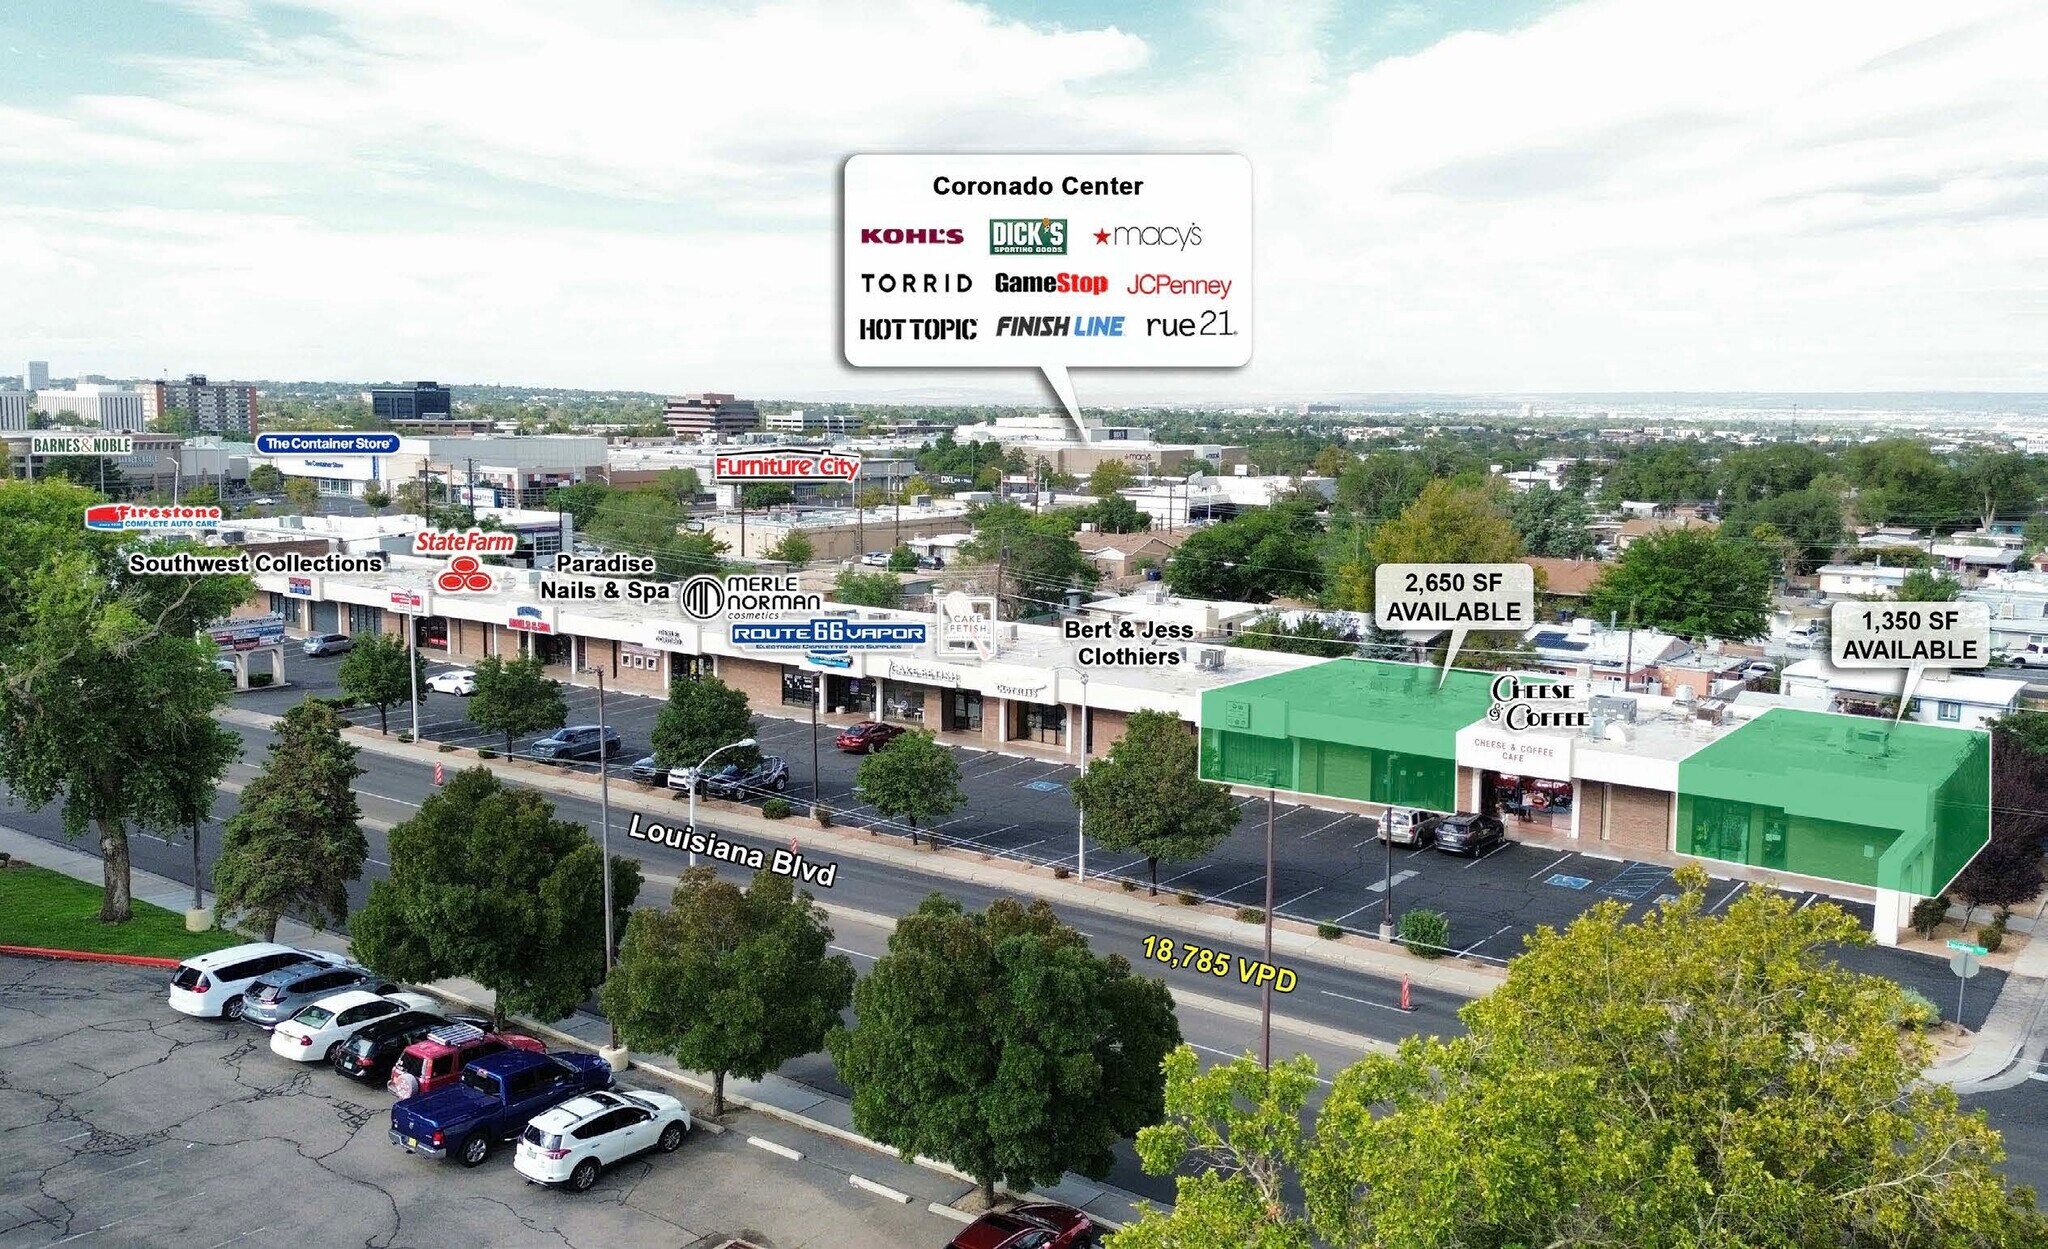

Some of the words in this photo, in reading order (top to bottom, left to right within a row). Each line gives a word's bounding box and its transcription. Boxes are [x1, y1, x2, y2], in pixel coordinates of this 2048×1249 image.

[940, 475, 955, 484] DXL
[1474, 738, 1506, 750] CHEESE
[1520, 745, 1554, 757] COFFEE
[1502, 752, 1524, 763] CAFE
